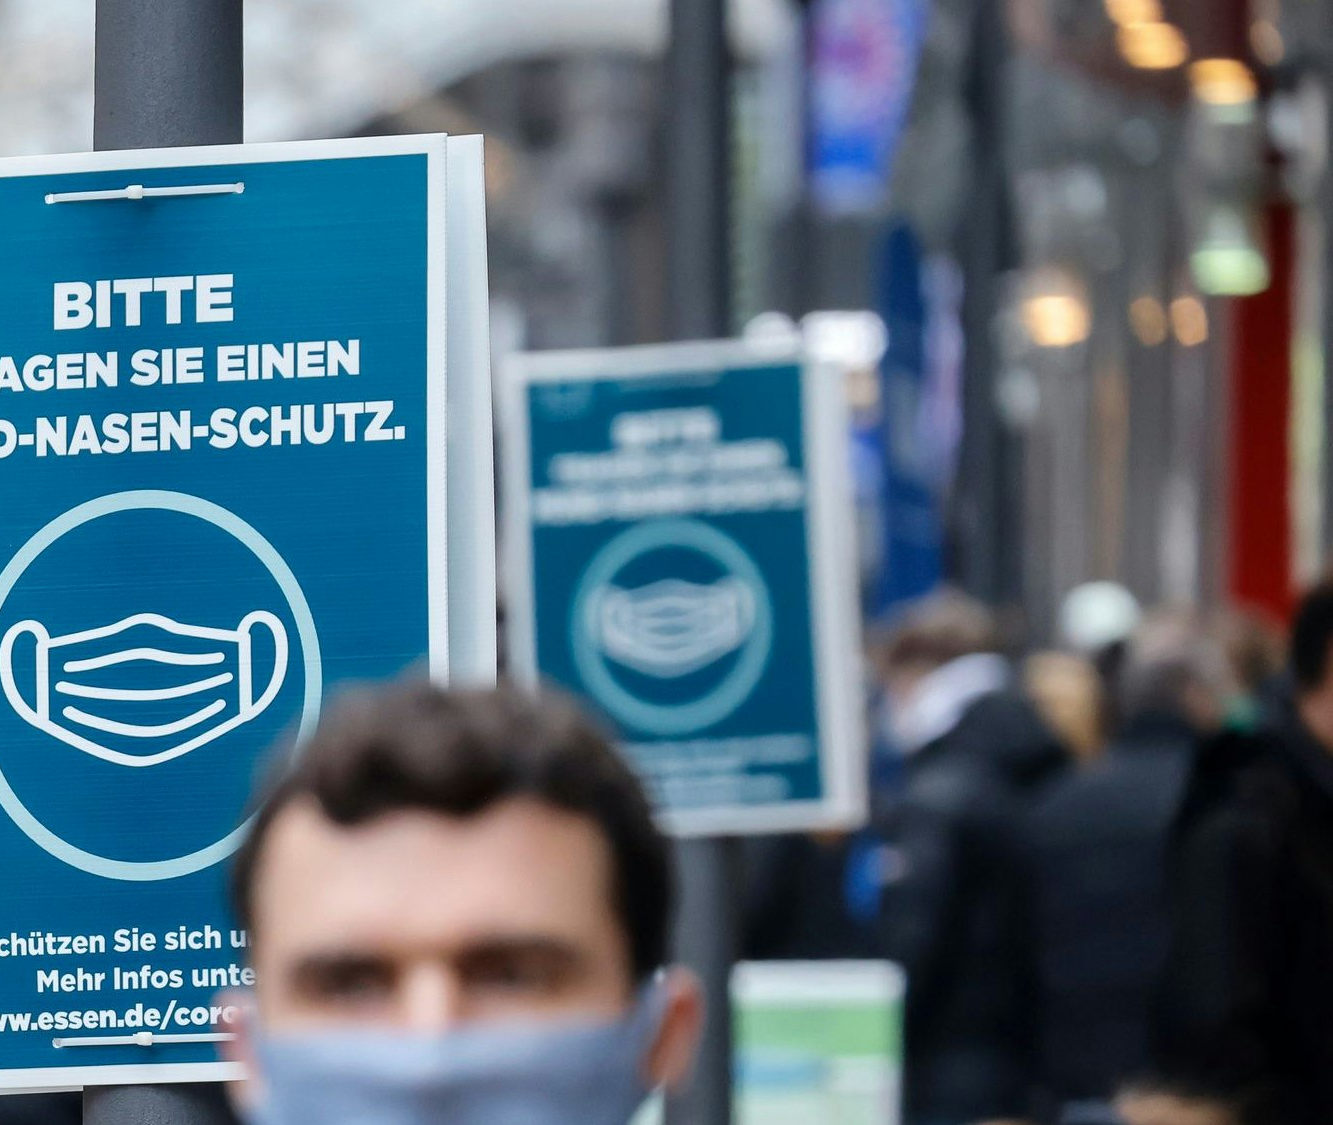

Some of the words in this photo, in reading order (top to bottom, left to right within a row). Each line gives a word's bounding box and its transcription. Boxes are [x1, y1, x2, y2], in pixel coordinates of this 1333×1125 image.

[53, 273, 234, 331] BITTE
[130, 347, 204, 386] SIE
[217, 340, 360, 382] EINEN
[113, 927, 157, 954] Sie
[164, 924, 222, 951] sich
[36, 968, 106, 993] Mehr
[113, 964, 184, 990] Infos
[192, 963, 256, 988] unte
